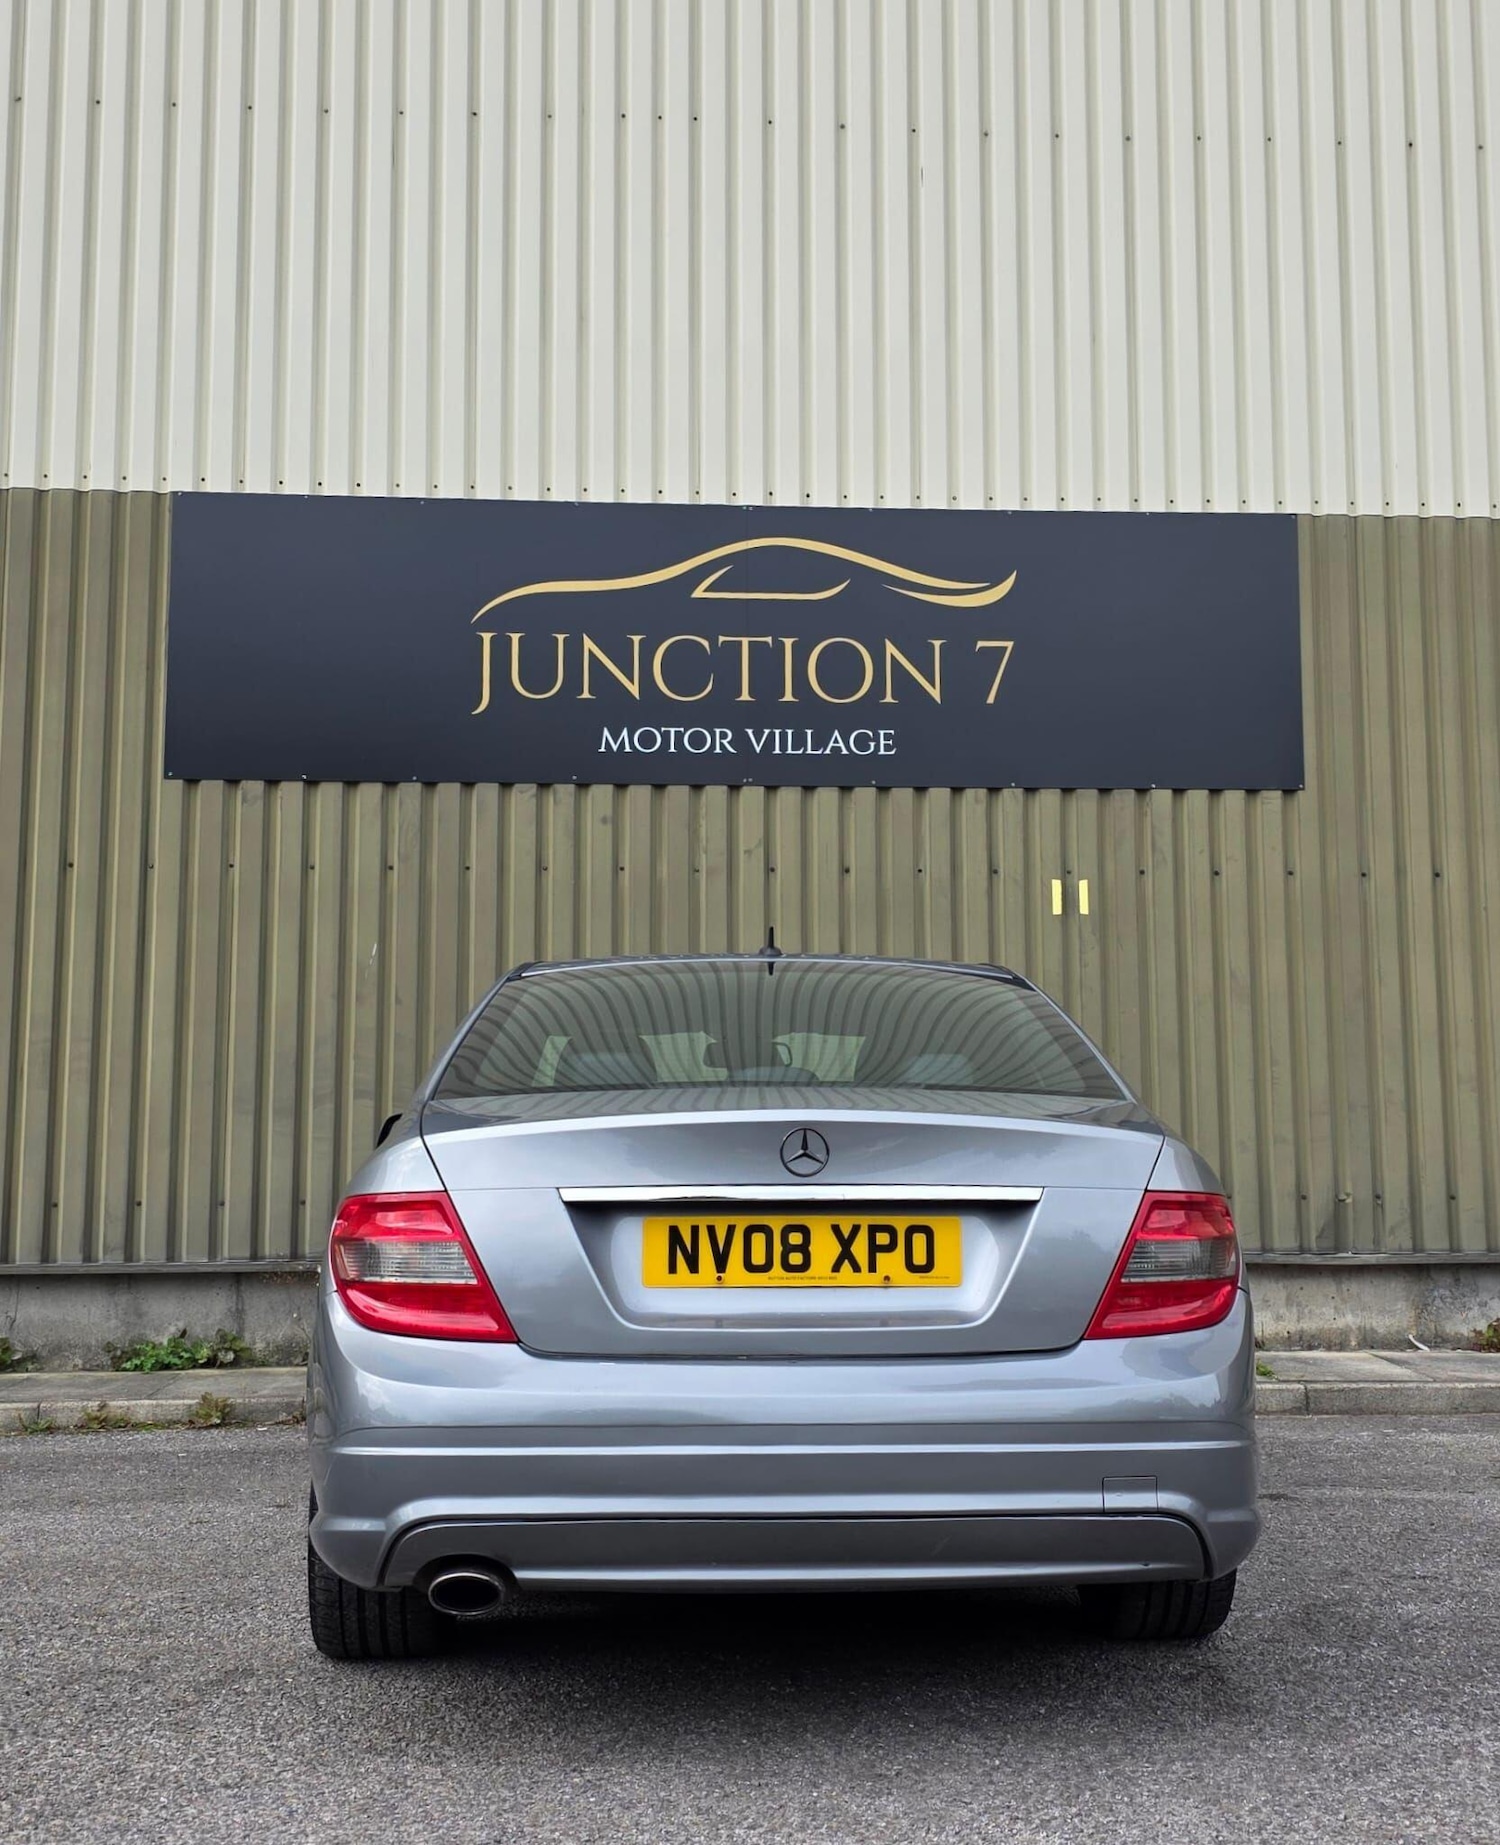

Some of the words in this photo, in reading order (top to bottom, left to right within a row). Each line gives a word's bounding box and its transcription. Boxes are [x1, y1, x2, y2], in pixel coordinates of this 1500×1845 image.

[472, 632, 947, 714] JUNCTION
[975, 640, 1015, 704] 7
[598, 727, 737, 754] MOTOR
[744, 728, 897, 755] VILLAGE
[668, 1224, 812, 1274] NV08
[830, 1224, 935, 1274] XPO
